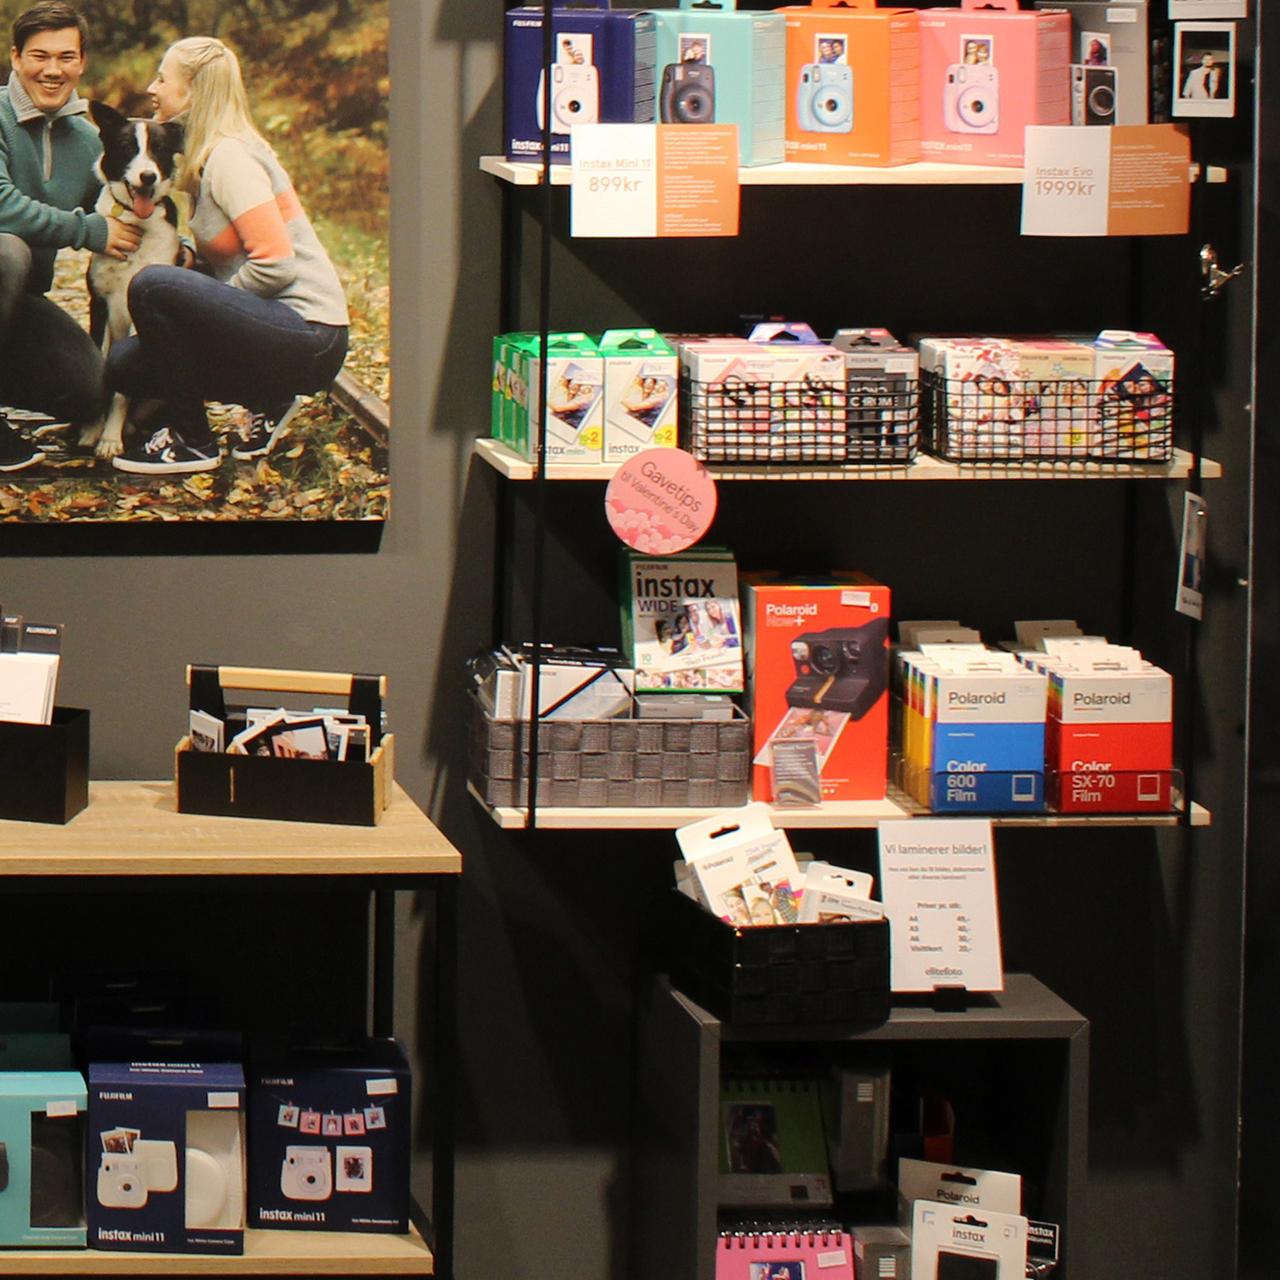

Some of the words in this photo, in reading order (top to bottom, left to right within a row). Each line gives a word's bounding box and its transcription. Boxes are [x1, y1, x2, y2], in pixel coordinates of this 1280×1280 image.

[512, 139, 542, 150] instax
[579, 159, 612, 169] Instax
[616, 159, 639, 168] Mini
[1036, 166, 1070, 177] Instax
[1073, 166, 1094, 177] Evo
[589, 176, 641, 192] 899kr
[1035, 180, 1096, 197] 1999kr
[608, 443, 640, 454] instax
[641, 460, 703, 513] Gavetips
[620, 471, 632, 483] til
[630, 477, 681, 520] Valentine's
[679, 511, 700, 533] Day
[635, 563, 669, 571] FUJIFILM
[636, 571, 716, 599] instax
[637, 599, 679, 613] WIDE
[766, 603, 818, 616] Polaroid
[948, 691, 1006, 705] Polaroid
[1073, 692, 1131, 705] Polaroid
[946, 759, 987, 772] Color
[1071, 760, 1112, 772] Color
[947, 775, 976, 788] 600
[1071, 775, 1116, 788] SX-70
[946, 788, 977, 802] Film
[1072, 789, 1102, 802] Film
[885, 844, 896, 854] Vi
[898, 844, 950, 854] laminerer
[952, 844, 987, 855] bilder!
[925, 966, 963, 976] elitefoto
[99, 1092, 133, 1101] FUJIFILM
[936, 1188, 980, 1205] Polaroid
[259, 1207, 293, 1221] instax
[293, 1211, 315, 1221] mini
[315, 1212, 326, 1222] 11
[98, 1227, 132, 1242] instax
[133, 1231, 155, 1243] mini
[155, 1231, 165, 1242] 11
[952, 1227, 985, 1243] instax
